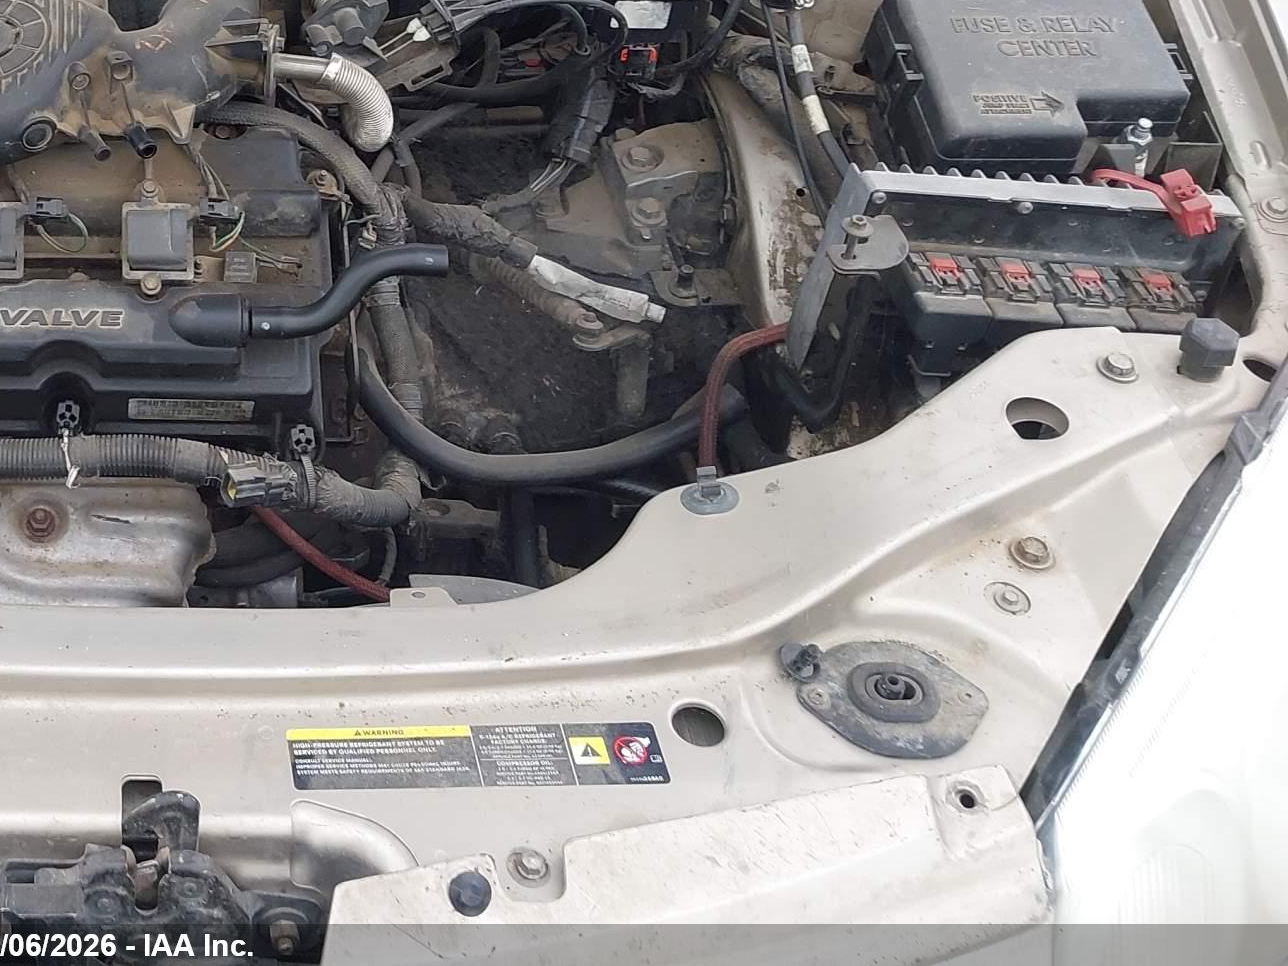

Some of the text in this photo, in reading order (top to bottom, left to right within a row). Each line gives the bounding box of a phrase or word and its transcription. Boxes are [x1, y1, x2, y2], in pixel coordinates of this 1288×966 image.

[948, 16, 1116, 33] FUSE & RELAY
[997, 40, 1097, 57] CENTER
